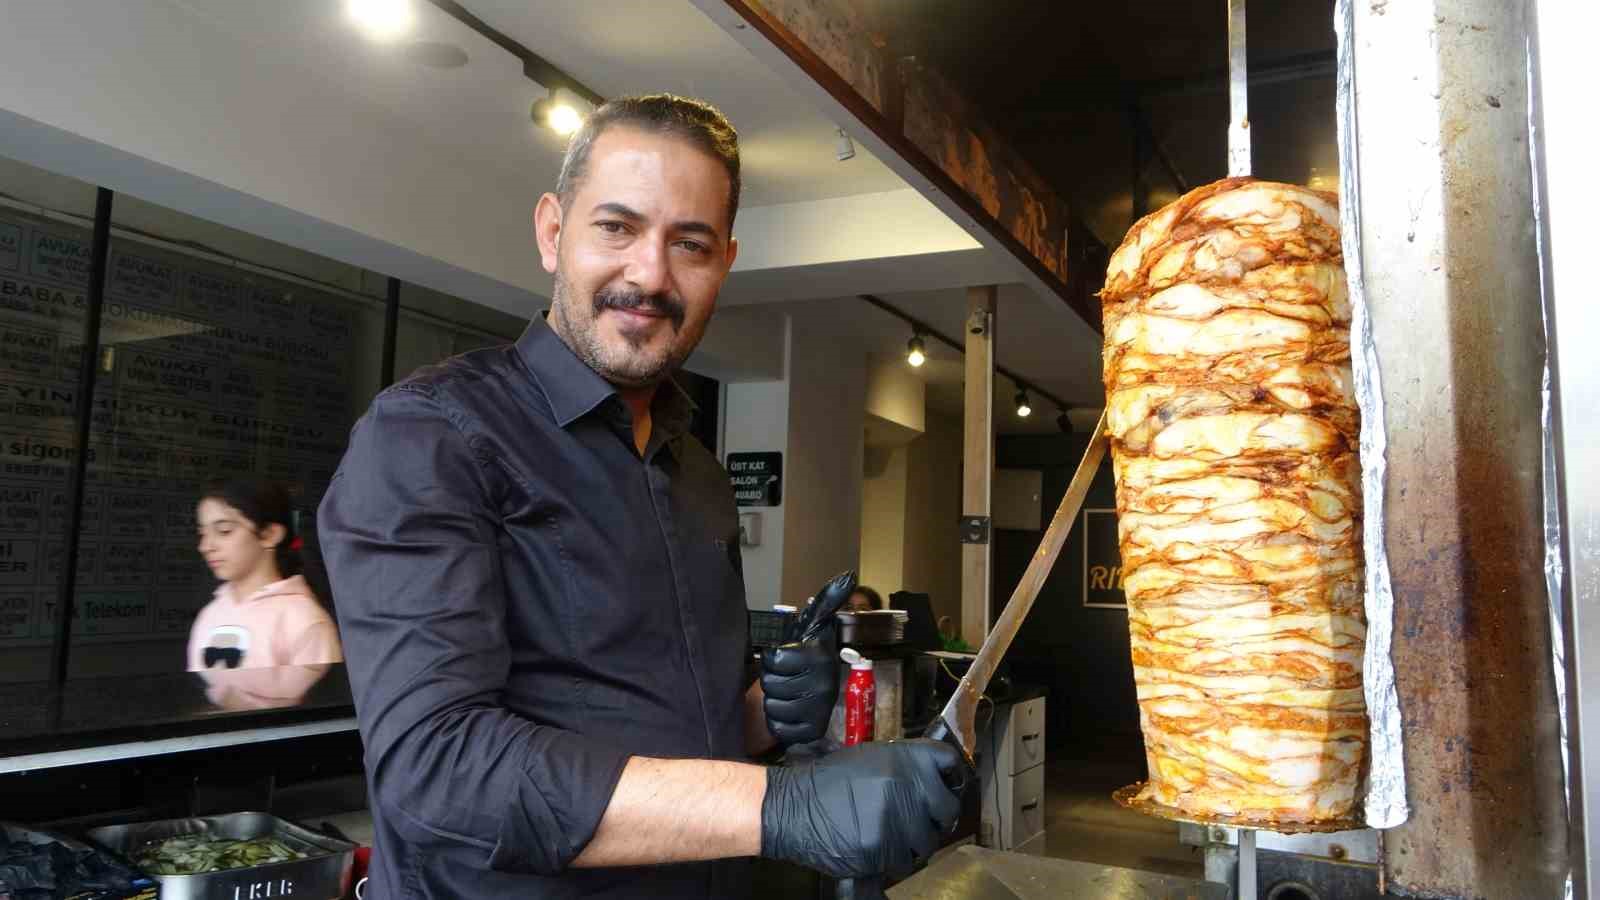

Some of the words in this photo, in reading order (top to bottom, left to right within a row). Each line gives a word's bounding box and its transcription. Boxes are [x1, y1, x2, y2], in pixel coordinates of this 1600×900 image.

[37, 235, 92, 258] AVUKA
[2, 281, 67, 305] BABA
[135, 354, 209, 377] AVUKAT
[749, 460, 766, 471] KAT
[730, 475, 758, 486] SALON
[85, 600, 147, 619] Telekom
